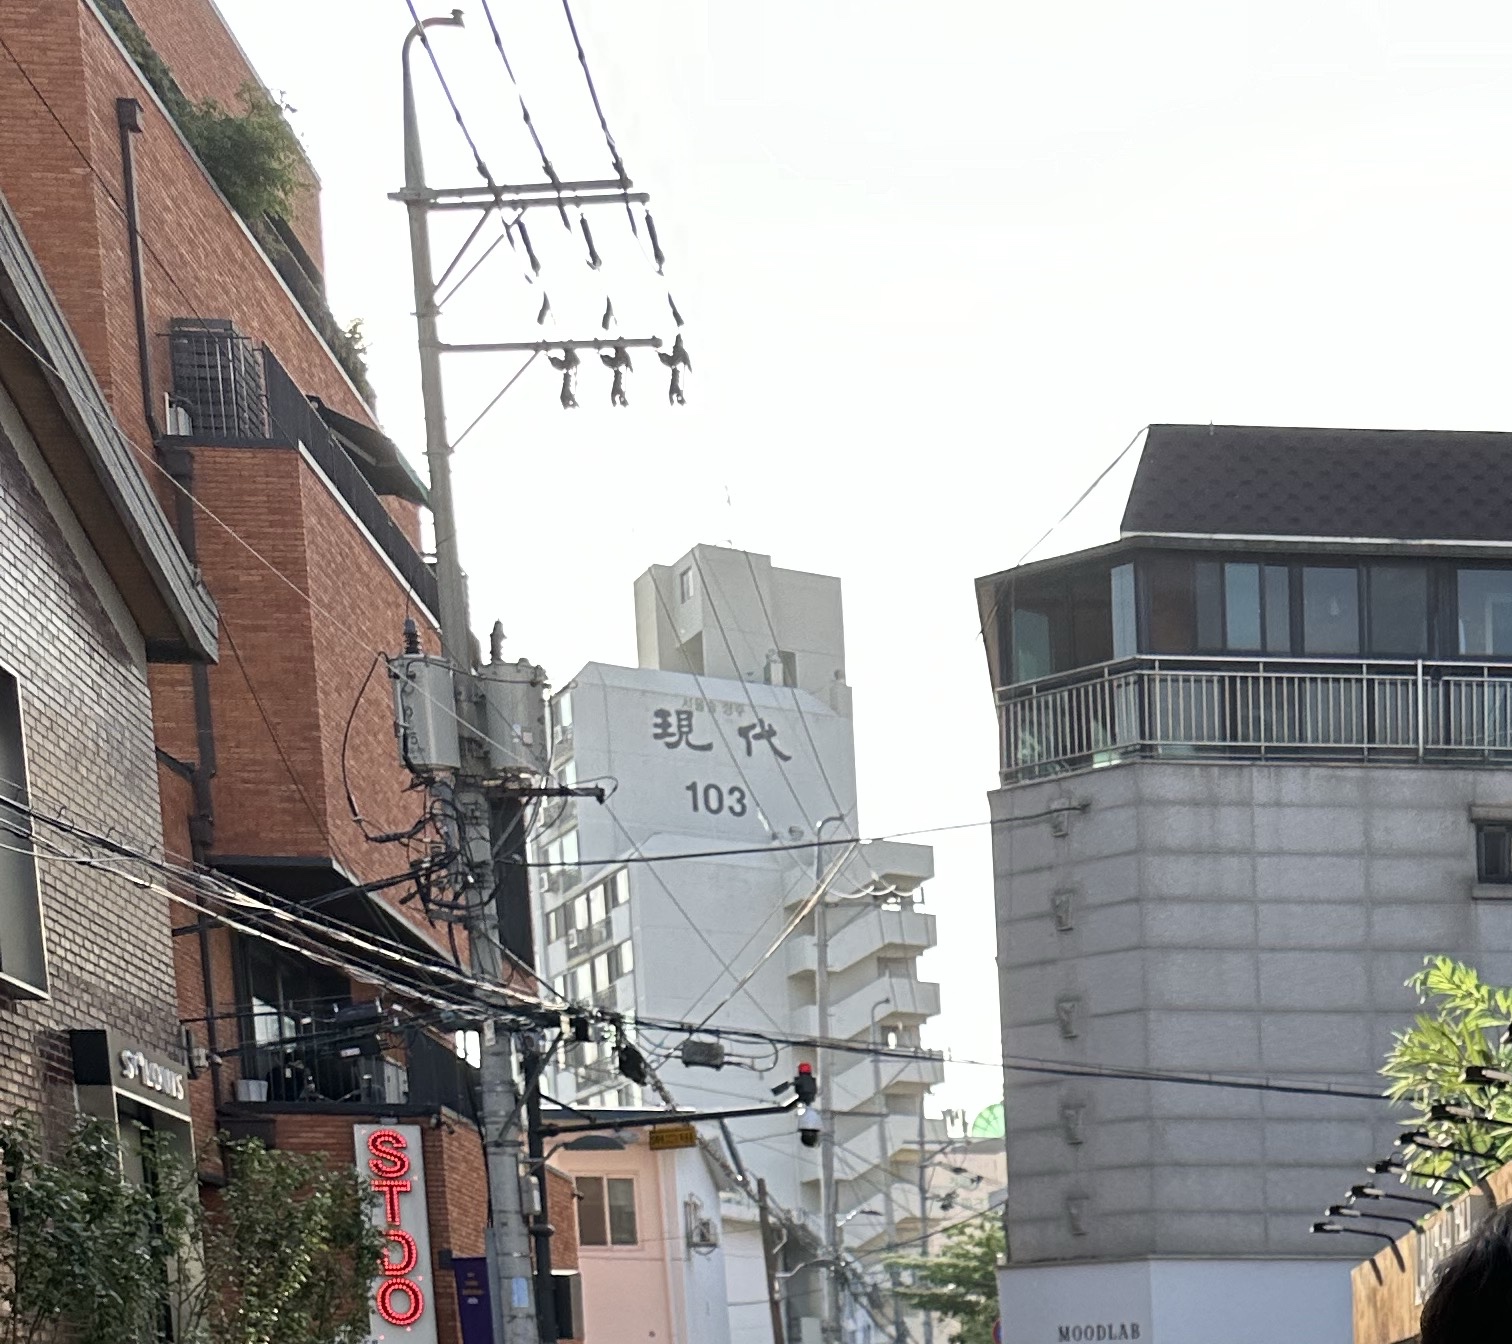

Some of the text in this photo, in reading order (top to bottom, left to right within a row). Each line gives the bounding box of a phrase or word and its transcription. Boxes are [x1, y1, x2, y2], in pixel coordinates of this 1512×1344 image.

[652, 707, 793, 762] 現代
[685, 780, 747, 817] 103
[1057, 1323, 1141, 1342] MOODLAB
